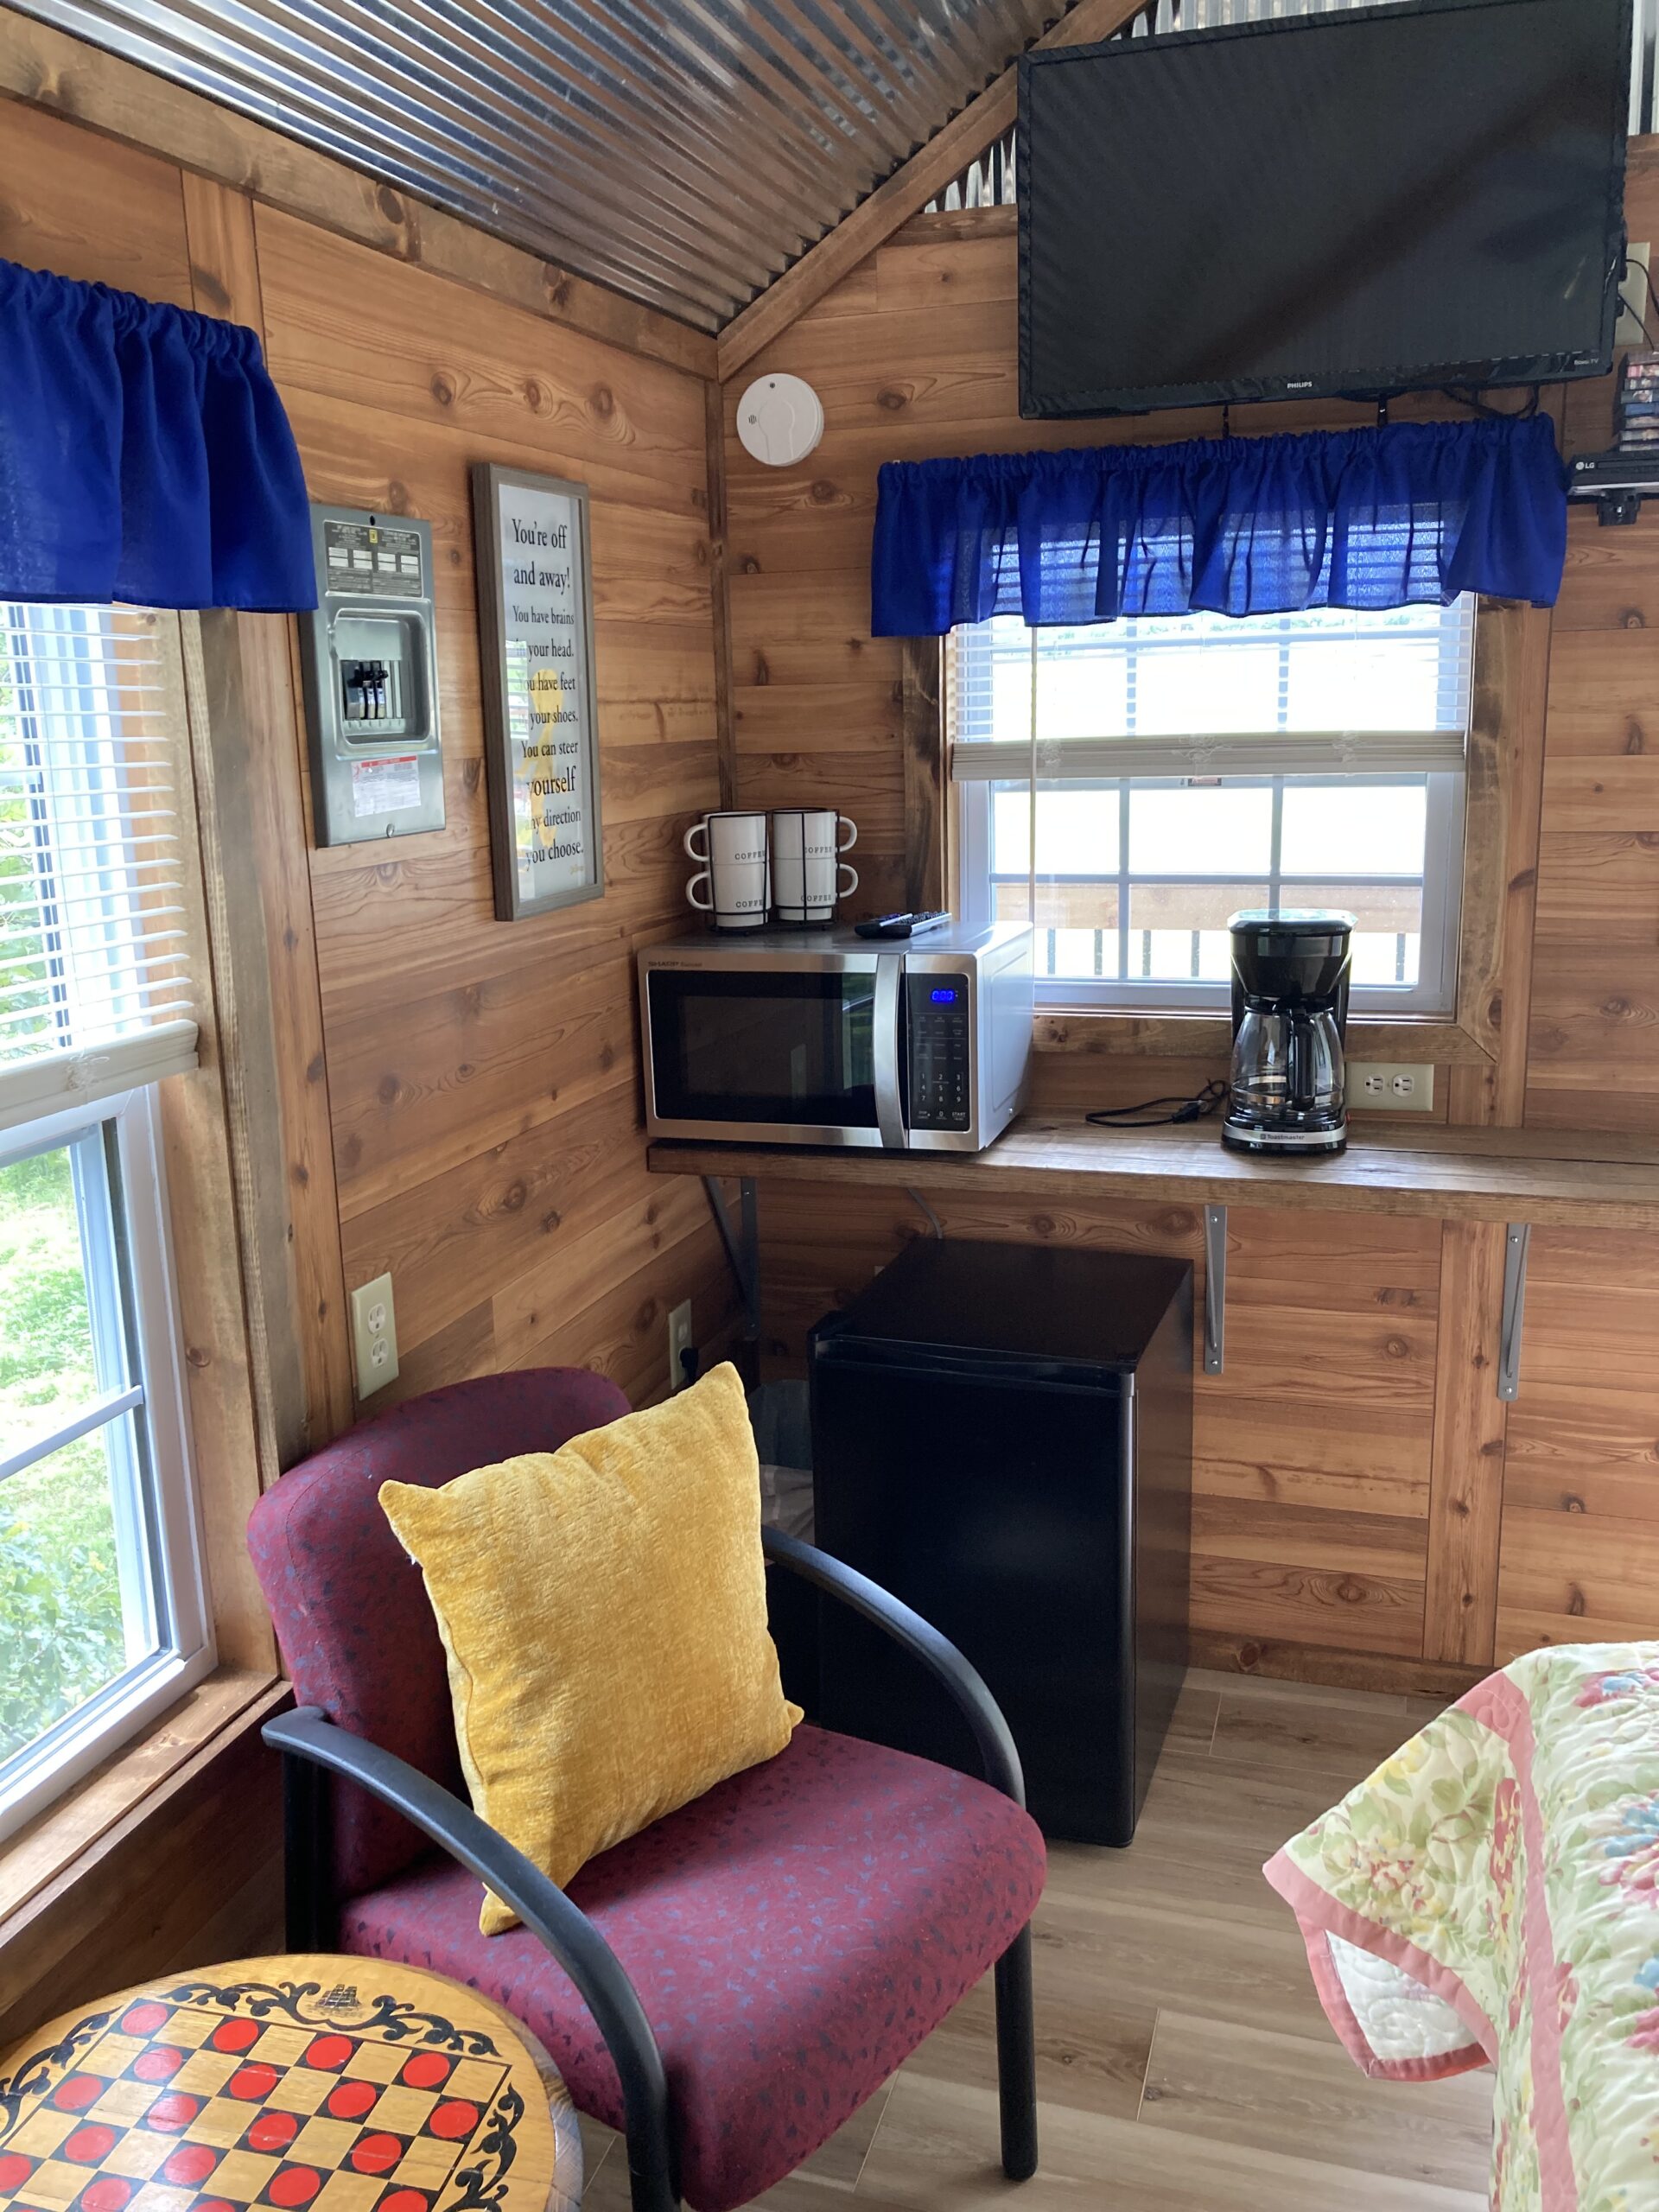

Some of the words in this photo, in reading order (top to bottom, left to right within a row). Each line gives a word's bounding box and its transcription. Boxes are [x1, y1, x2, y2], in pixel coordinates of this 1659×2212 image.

[512, 518, 548, 547] You're
[551, 524, 568, 550] off
[513, 560, 536, 586] and
[538, 566, 570, 595] away!
[512, 605, 529, 623] You
[531, 606, 550, 624] have
[550, 607, 575, 625] brains
[527, 644, 549, 663] your
[550, 638, 575, 658] head.
[537, 671, 558, 691] have
[560, 671, 576, 690] feet
[529, 712, 550, 730] your
[553, 704, 579, 723] shoes.
[521, 740, 539, 758] You
[541, 744, 556, 757] can
[558, 741, 579, 755] steer
[525, 765, 577, 797] yourself
[543, 805, 582, 828] direction
[525, 849, 545, 872] you
[548, 837, 584, 861] choose.
